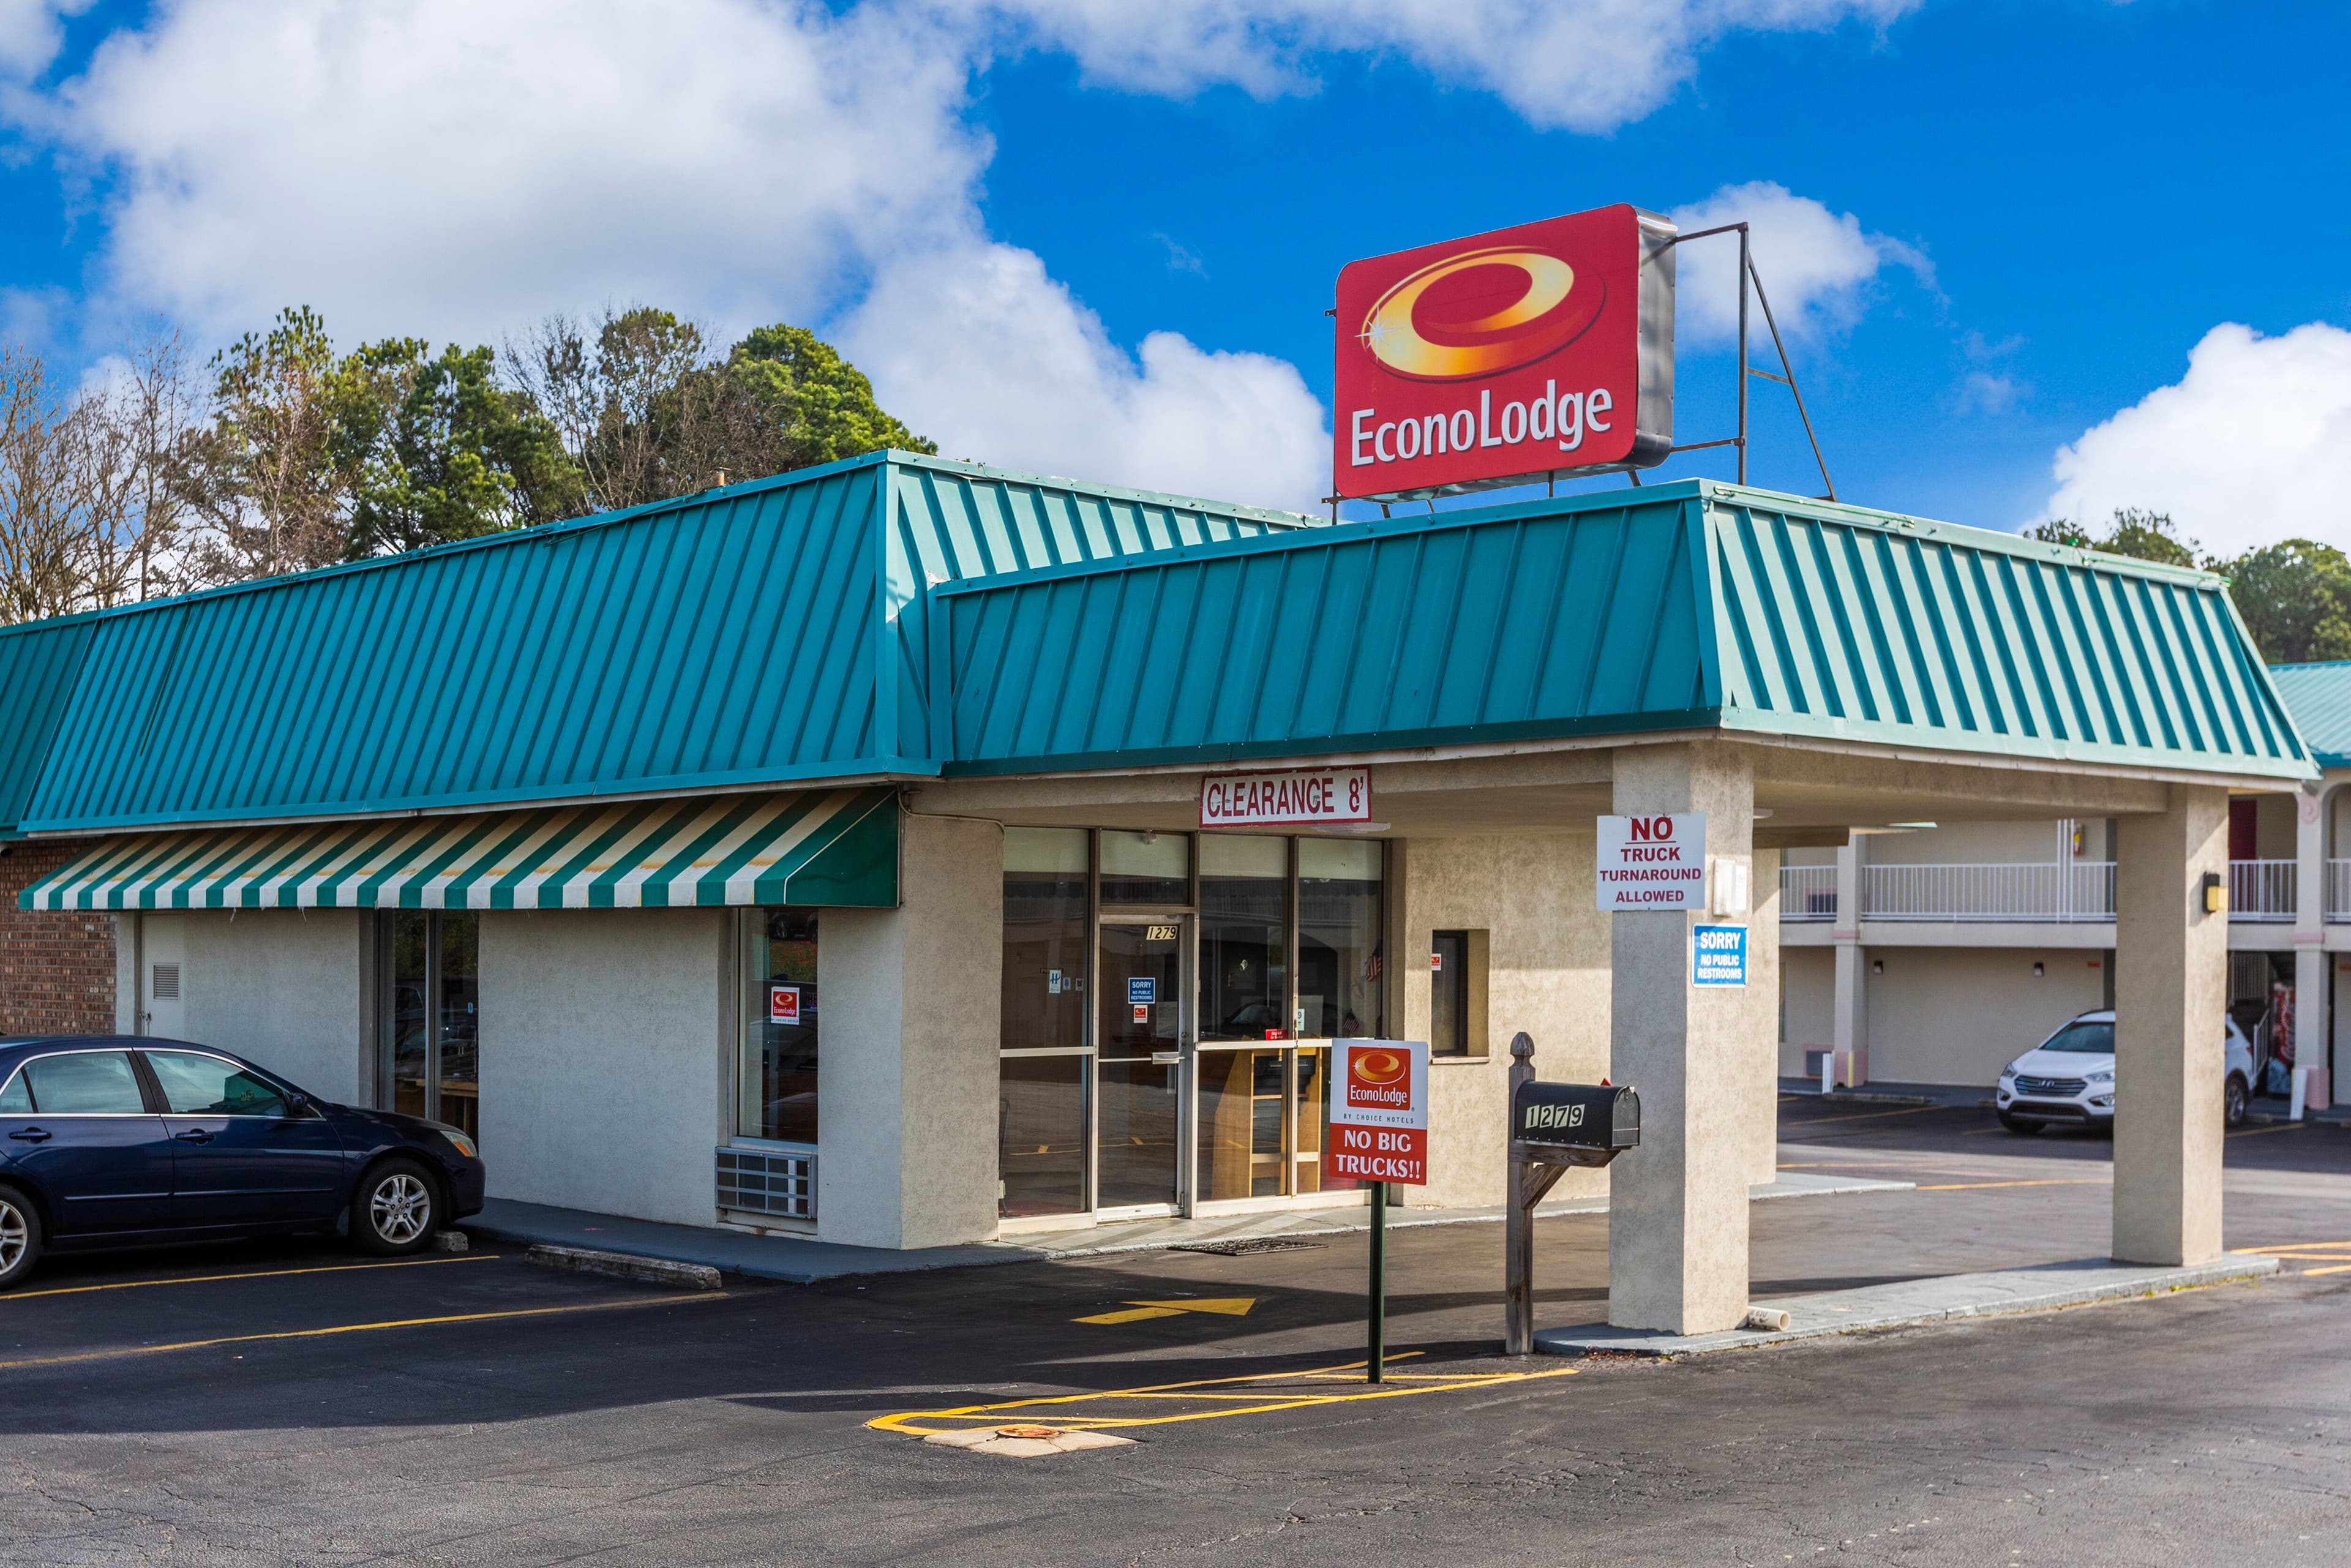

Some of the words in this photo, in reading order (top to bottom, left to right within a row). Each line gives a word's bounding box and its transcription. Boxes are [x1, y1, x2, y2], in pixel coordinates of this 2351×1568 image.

[1351, 379, 1613, 467] EconoLodge
[1207, 778, 1335, 817] CLEARANCE
[1348, 776, 1364, 813] 8'
[1630, 817, 1673, 841] NO
[1621, 847, 1681, 862] TRUCK
[1600, 868, 1701, 882] TURNAROUND
[1615, 890, 1684, 902] ALLOWED
[1149, 926, 1177, 939] 1279
[1700, 931, 1741, 950] SORRY
[1700, 954, 1712, 966] NO
[1713, 954, 1739, 966] PUBLIC
[1697, 967, 1742, 980] RESTROOMS
[1350, 1084, 1408, 1106] EconoLodge
[1529, 1106, 1583, 1127] 1279
[1344, 1130, 1371, 1149] NO
[1378, 1132, 1412, 1152] BIG
[1335, 1153, 1420, 1179] TRUCKS!!
